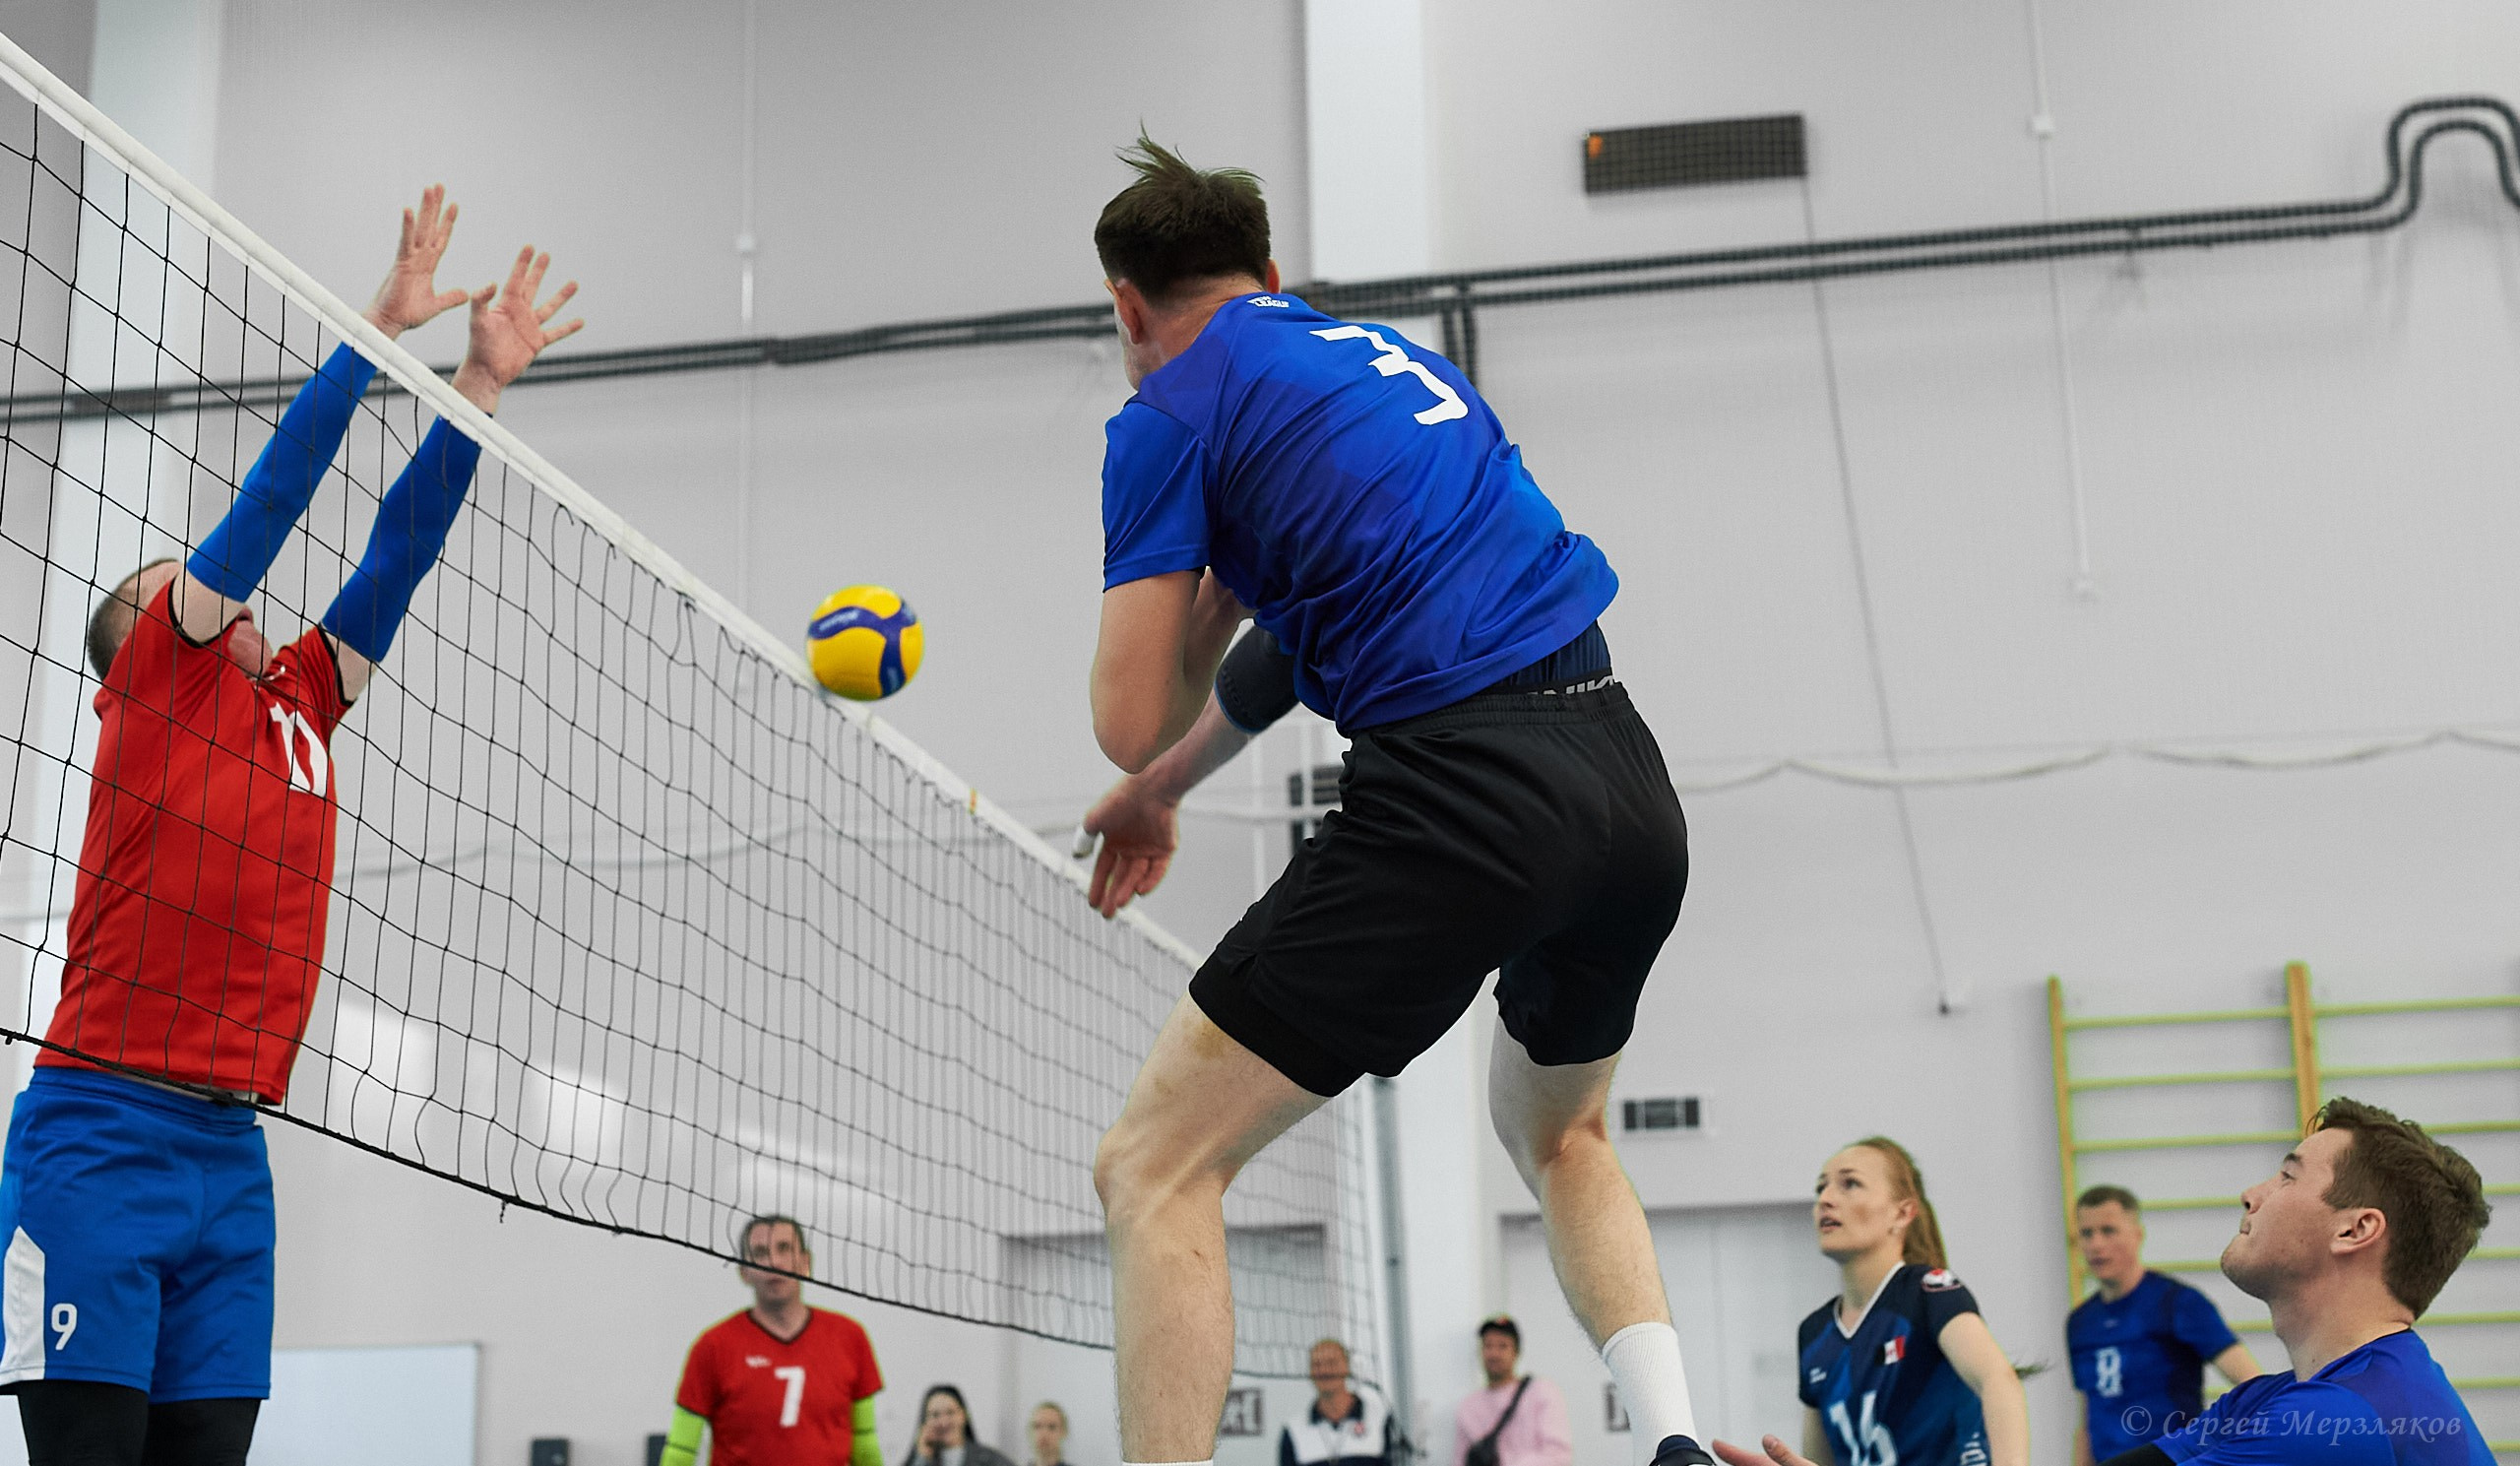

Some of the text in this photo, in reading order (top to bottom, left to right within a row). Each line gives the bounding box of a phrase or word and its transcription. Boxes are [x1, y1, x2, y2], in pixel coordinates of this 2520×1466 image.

[1308, 325, 1470, 425] 3
[51, 1303, 78, 1351] 9
[774, 1366, 806, 1427] 7
[2096, 1346, 2123, 1397] 8
[1828, 1389, 1900, 1466] 16
